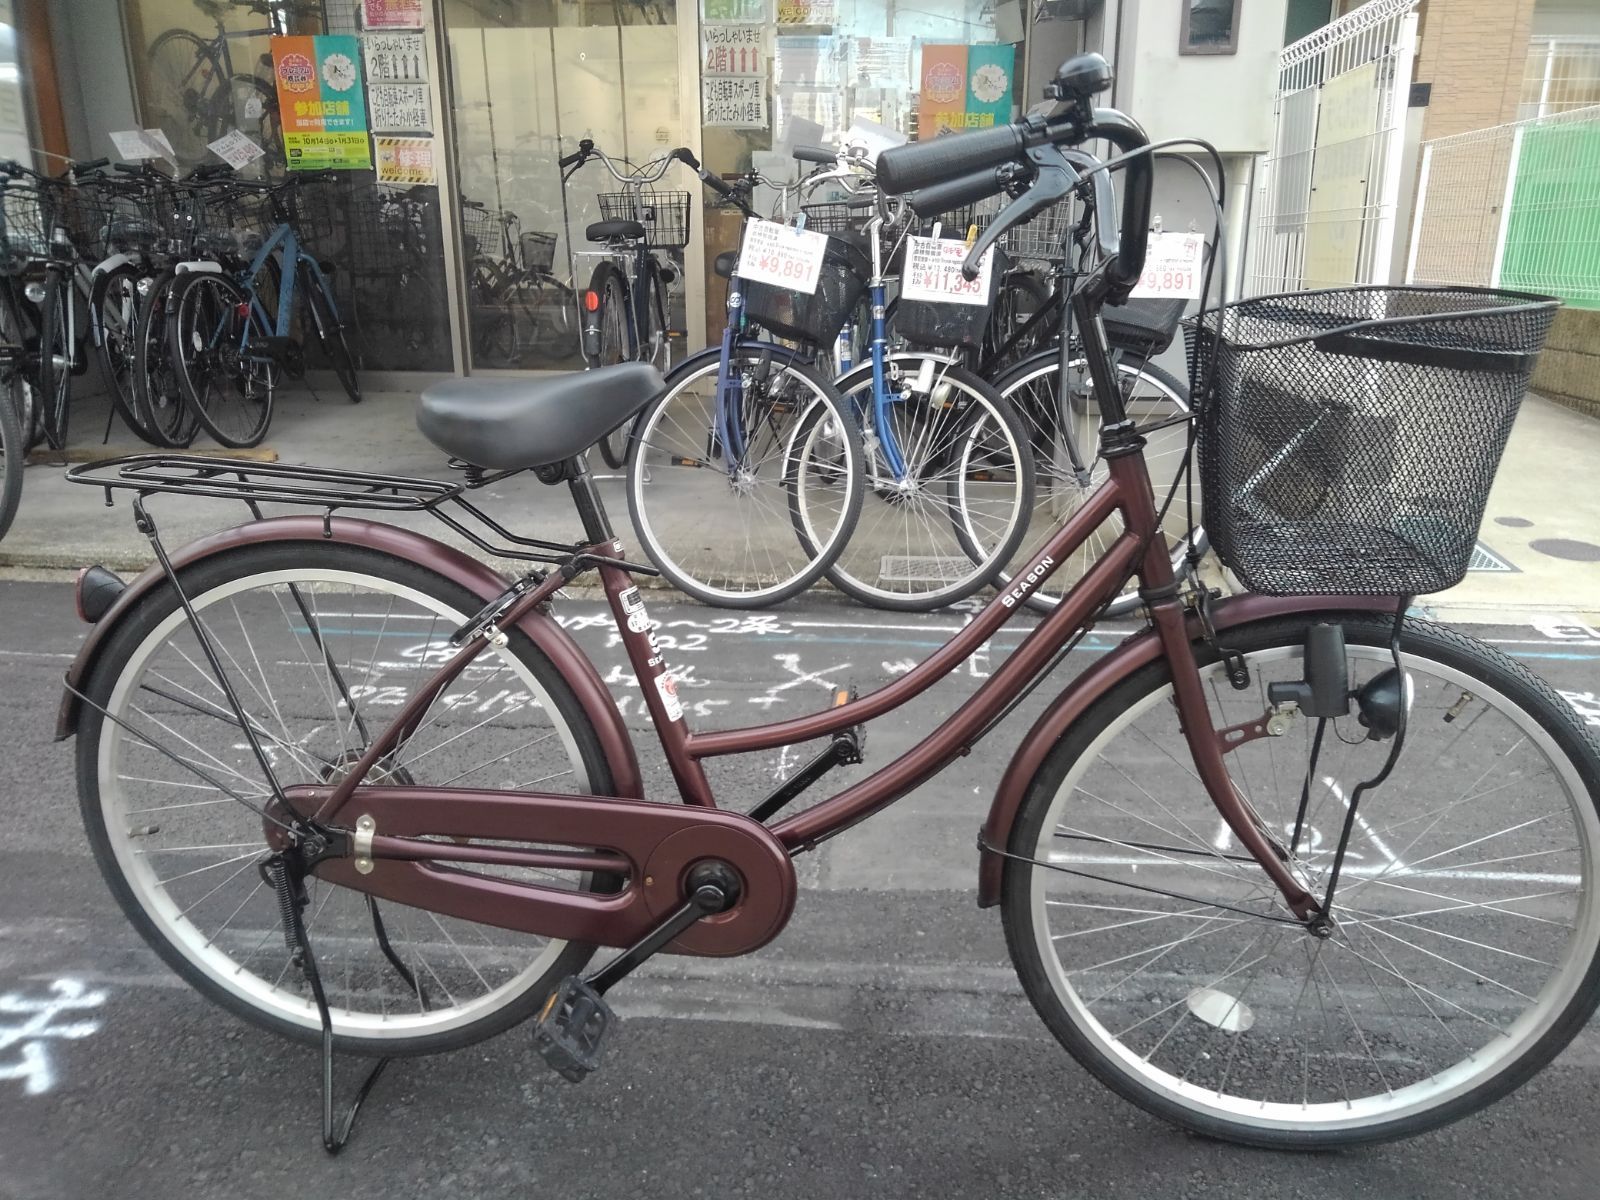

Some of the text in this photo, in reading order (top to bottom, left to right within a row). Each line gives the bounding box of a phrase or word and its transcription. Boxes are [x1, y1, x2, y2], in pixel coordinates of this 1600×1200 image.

[367, 35, 421, 51] いらっしゃいませ
[704, 28, 760, 44] いらっしゃいませ
[370, 53, 390, 79] 2階
[708, 45, 727, 73] 2階
[294, 100, 350, 116] 参加店舗
[758, 254, 814, 281] ¥9,891
[1001, 555, 1054, 607] SEASON
